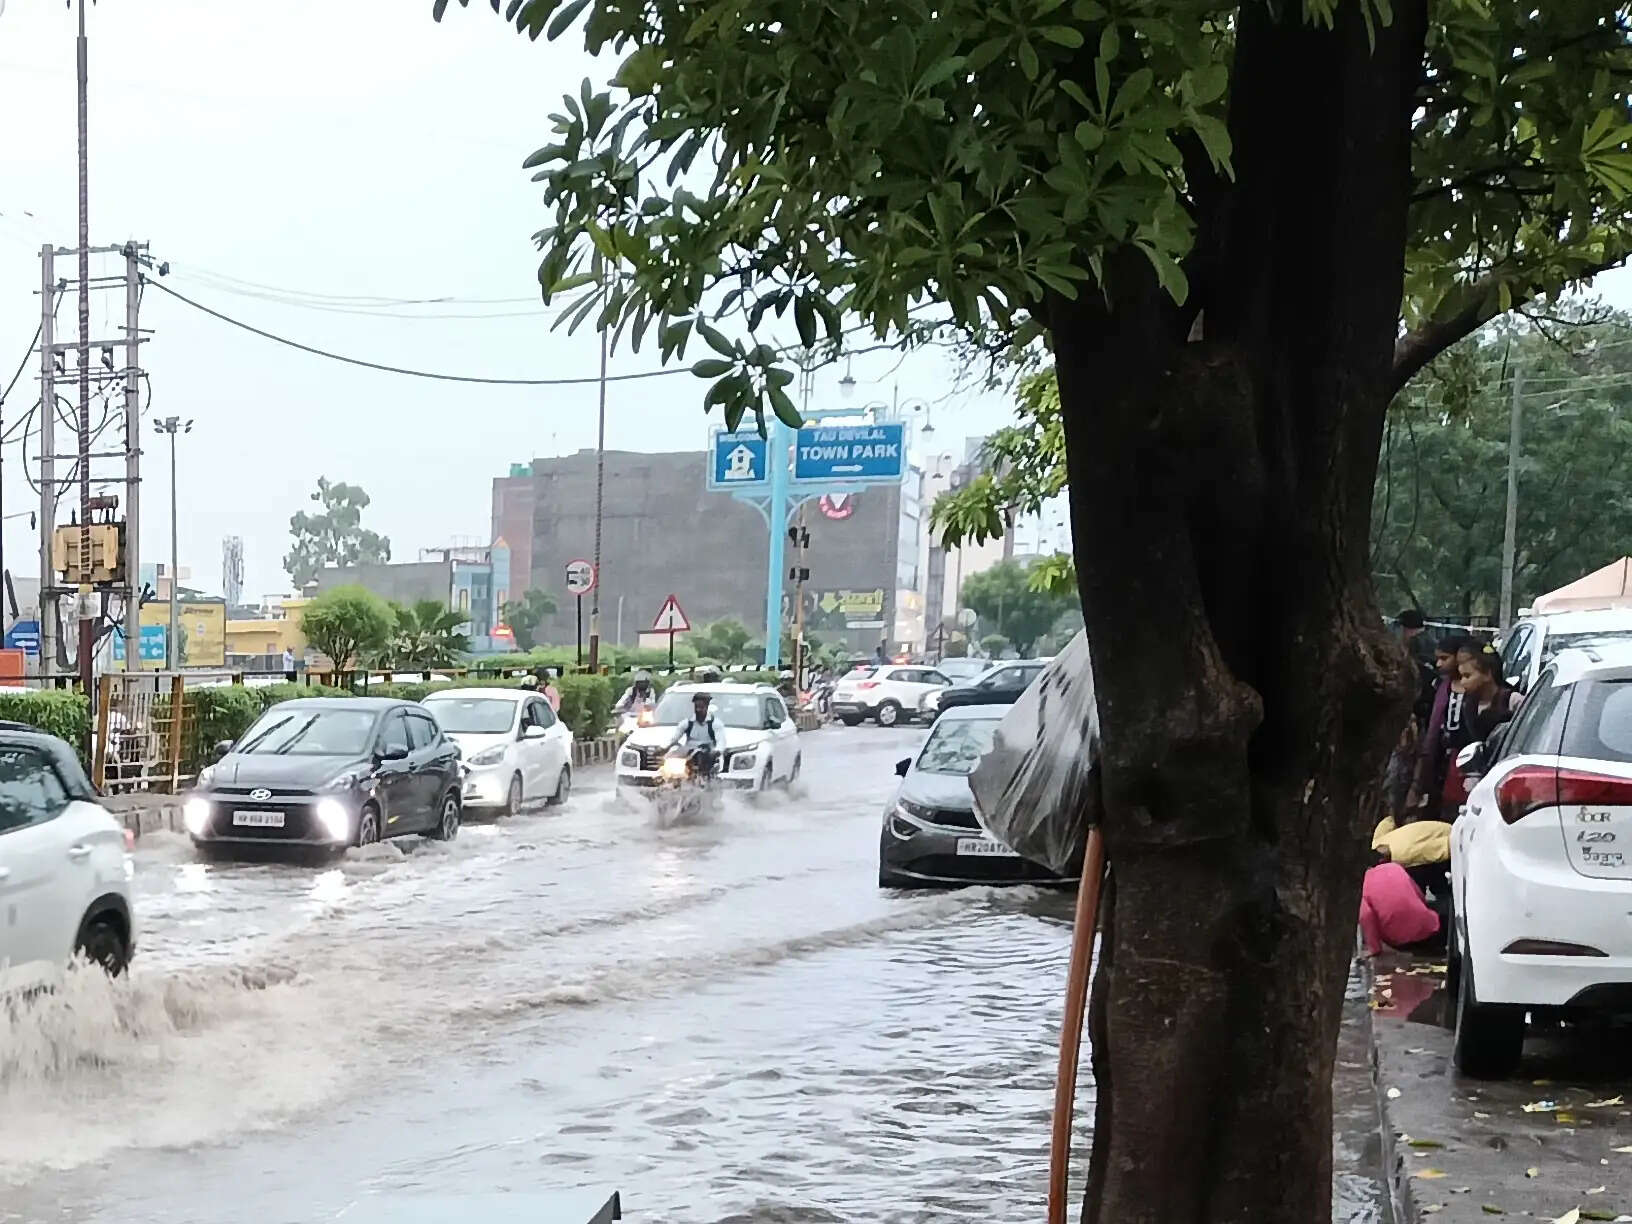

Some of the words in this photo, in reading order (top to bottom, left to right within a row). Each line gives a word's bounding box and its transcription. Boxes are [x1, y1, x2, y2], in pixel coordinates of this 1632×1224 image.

[813, 431, 837, 442] TAU
[801, 447, 848, 461] TOWN
[853, 443, 898, 459] PARK
